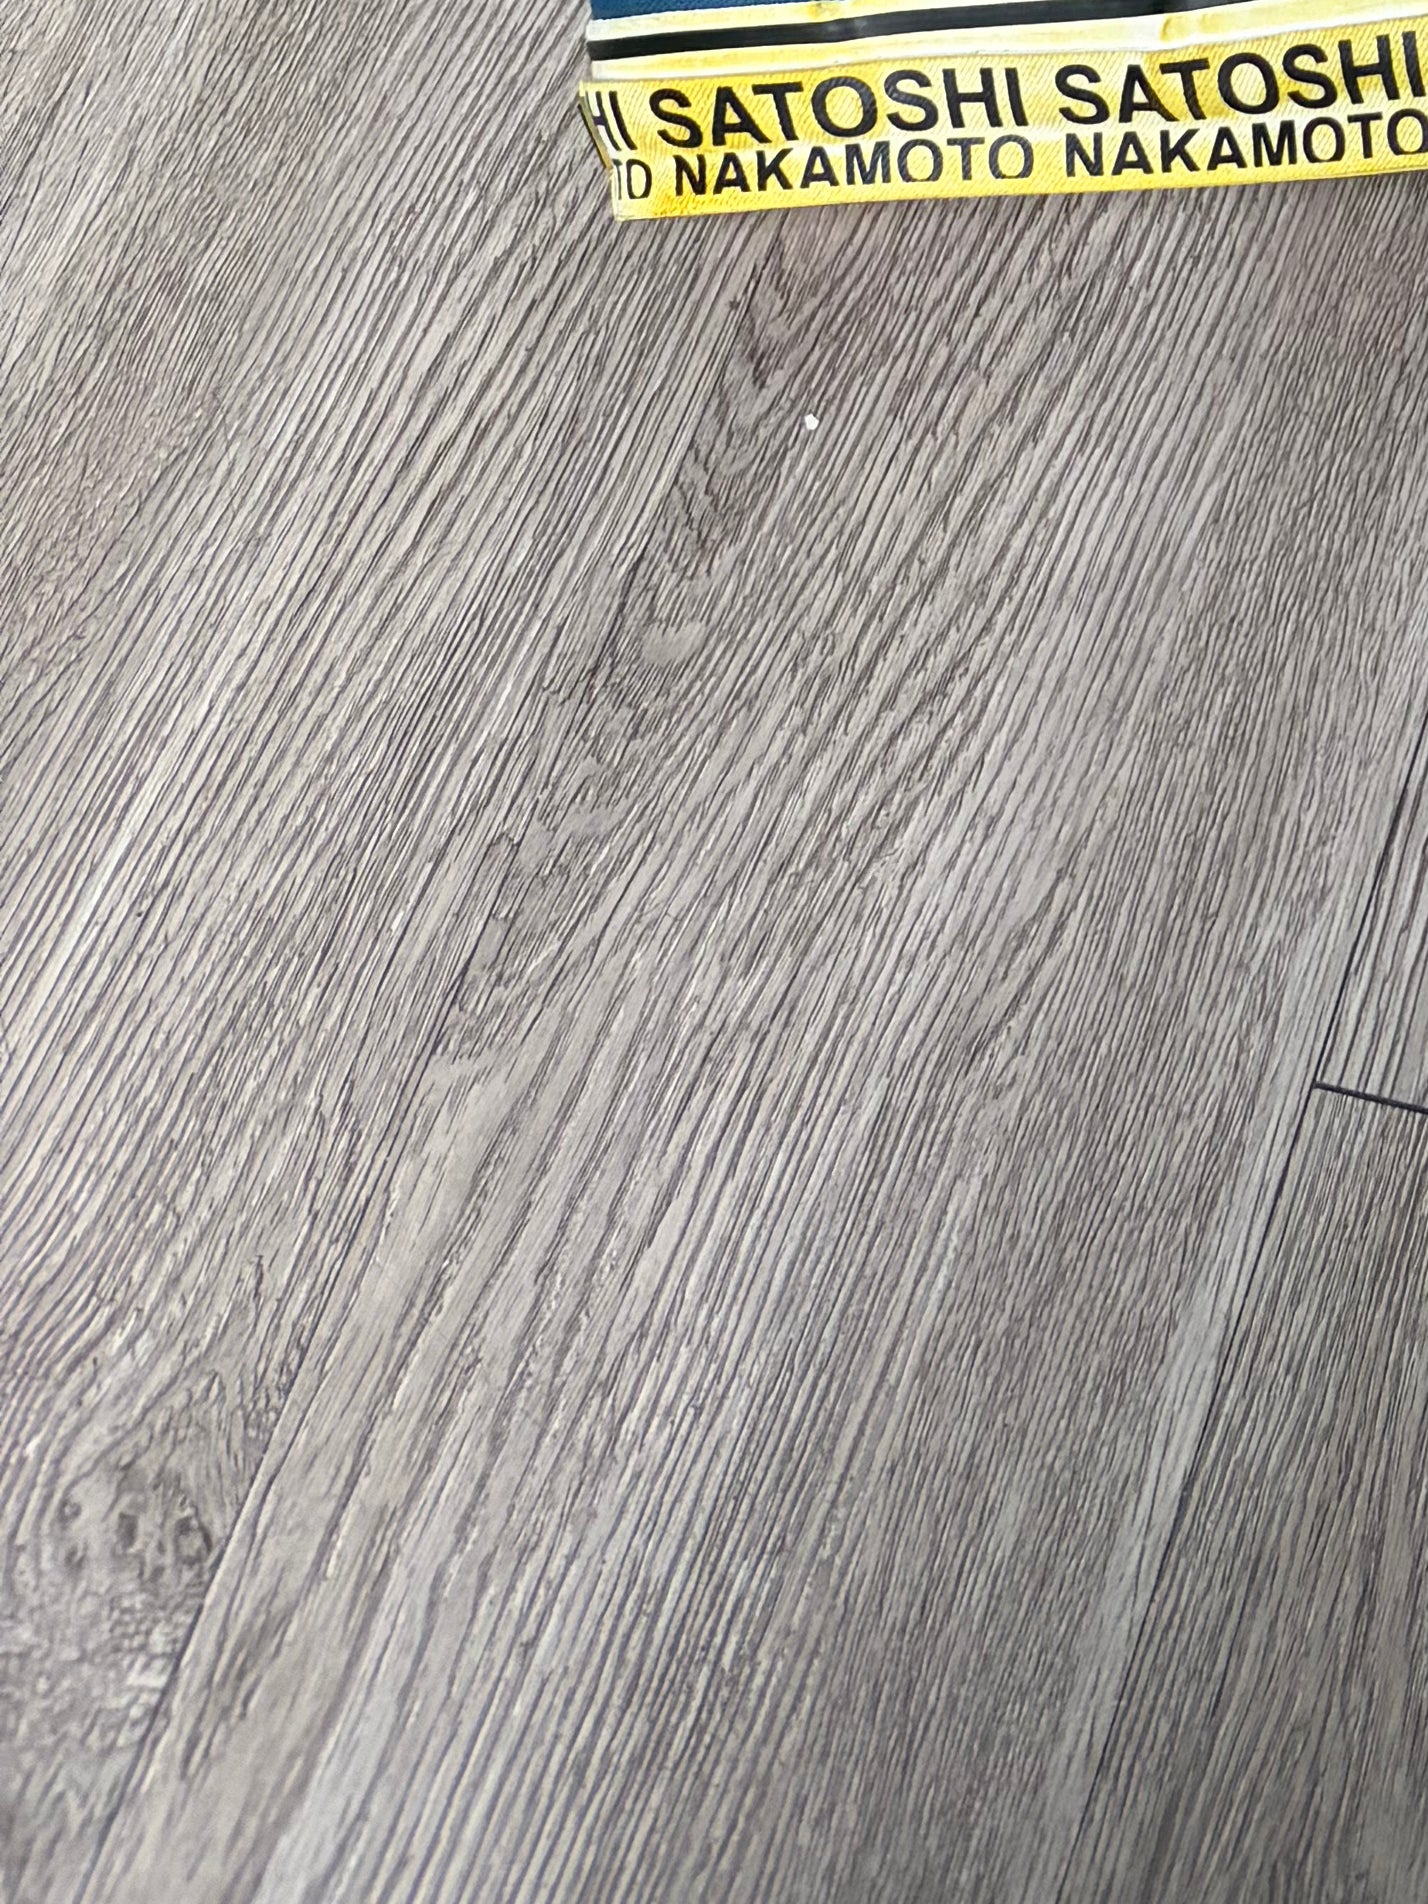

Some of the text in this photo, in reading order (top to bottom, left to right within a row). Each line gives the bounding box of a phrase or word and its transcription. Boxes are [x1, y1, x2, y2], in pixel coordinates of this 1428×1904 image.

[647, 66, 1030, 149] SATOSHI
[1054, 30, 1427, 126] SATOSHI
[674, 134, 1035, 198] NAKAMOTO
